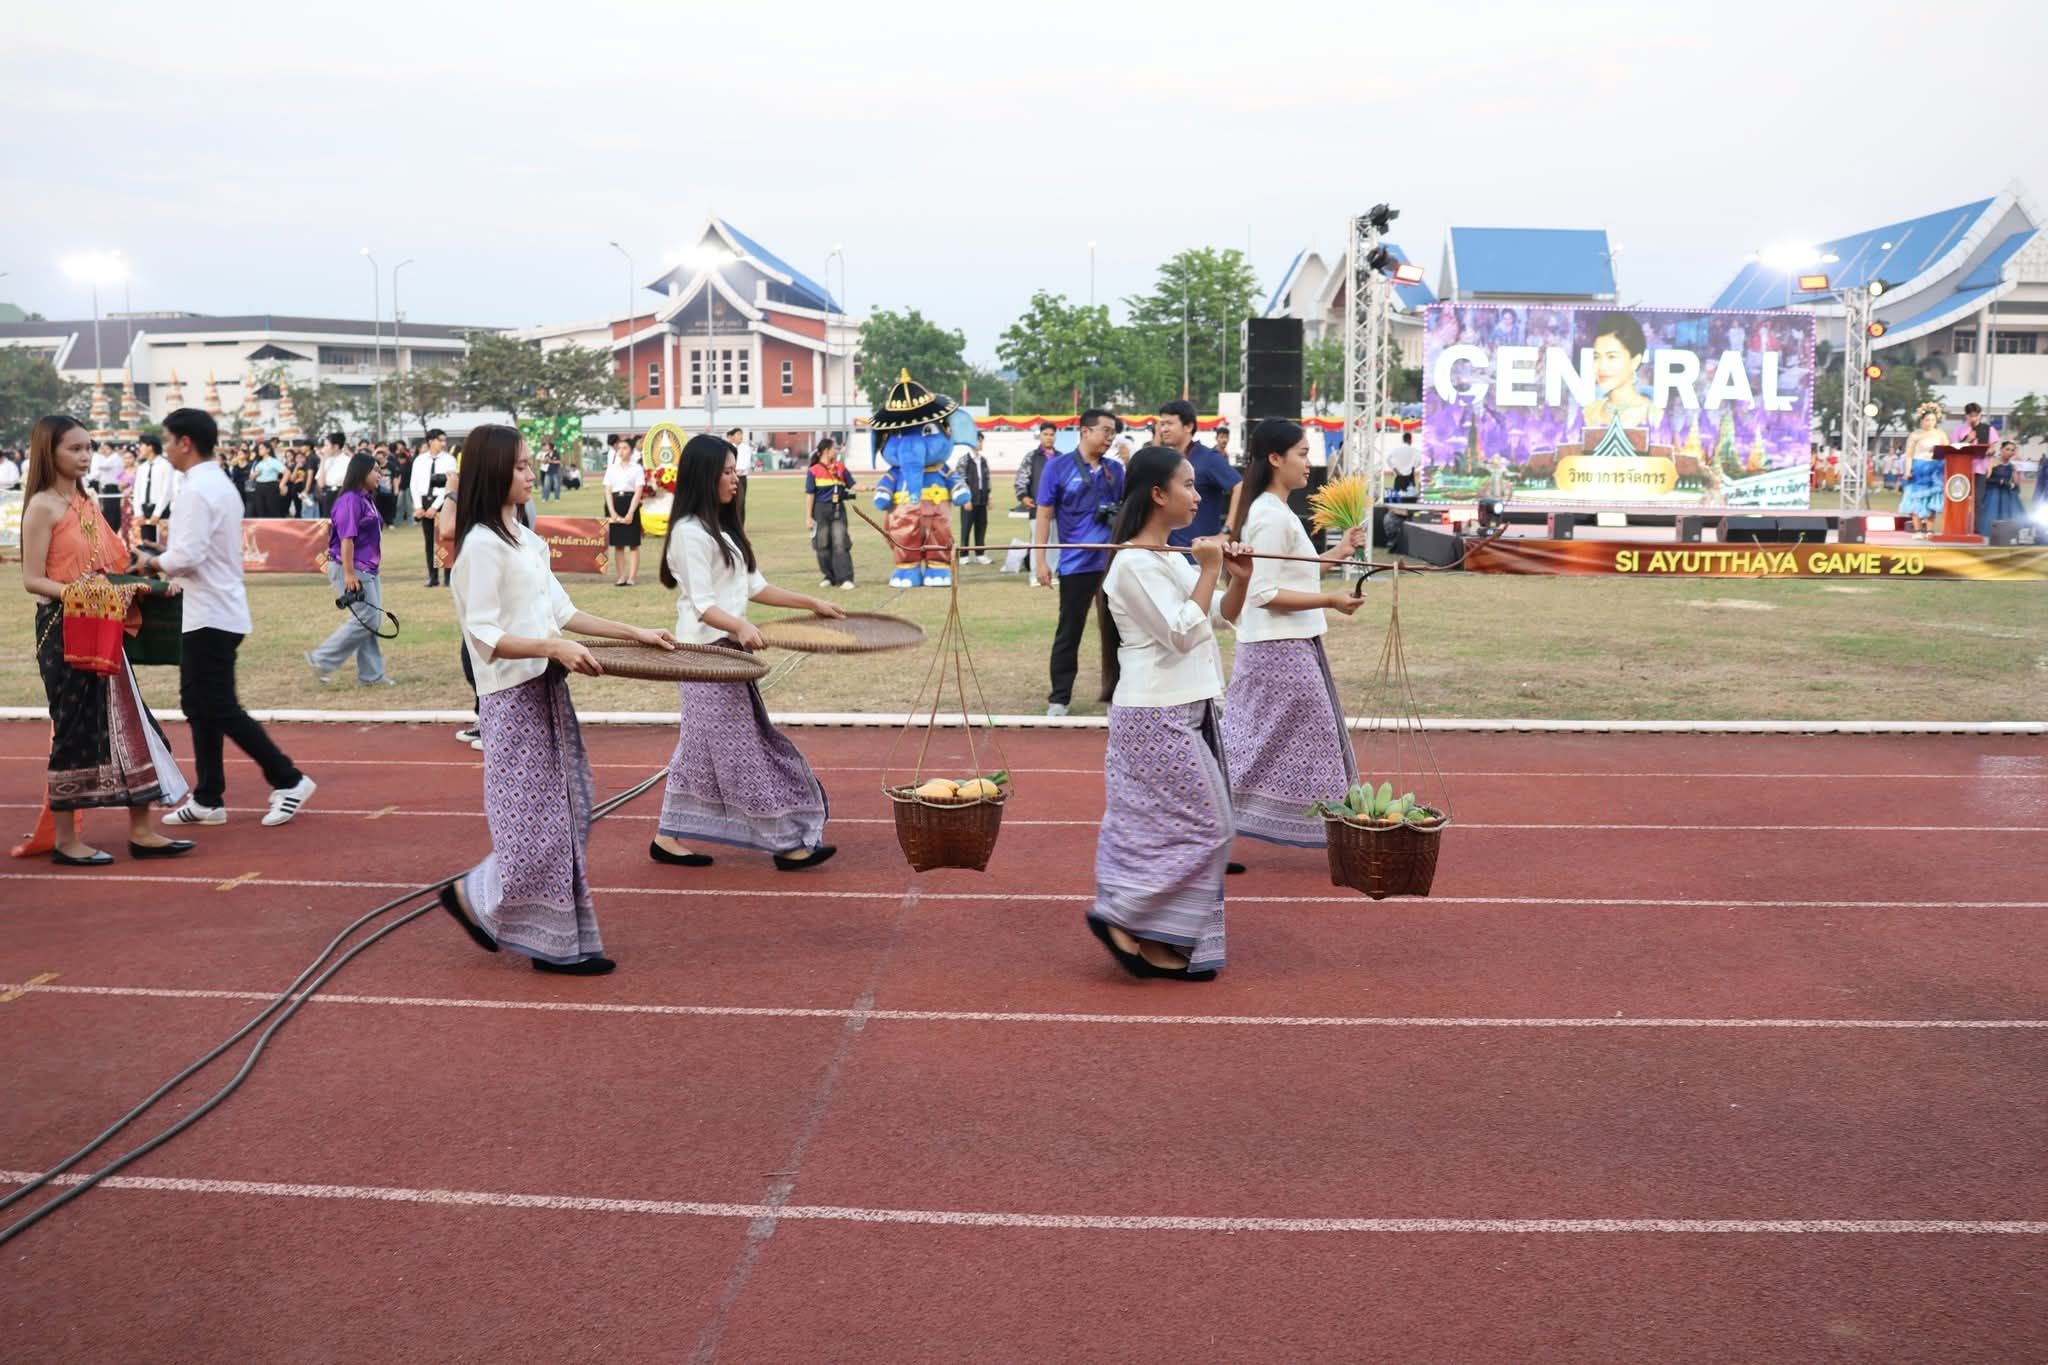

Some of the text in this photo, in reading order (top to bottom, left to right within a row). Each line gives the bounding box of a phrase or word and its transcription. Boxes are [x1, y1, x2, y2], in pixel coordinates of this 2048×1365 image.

[1432, 343, 1799, 412] CENRAL
[1615, 550, 1925, 575] SI AYUTTHAYA GAME 20
